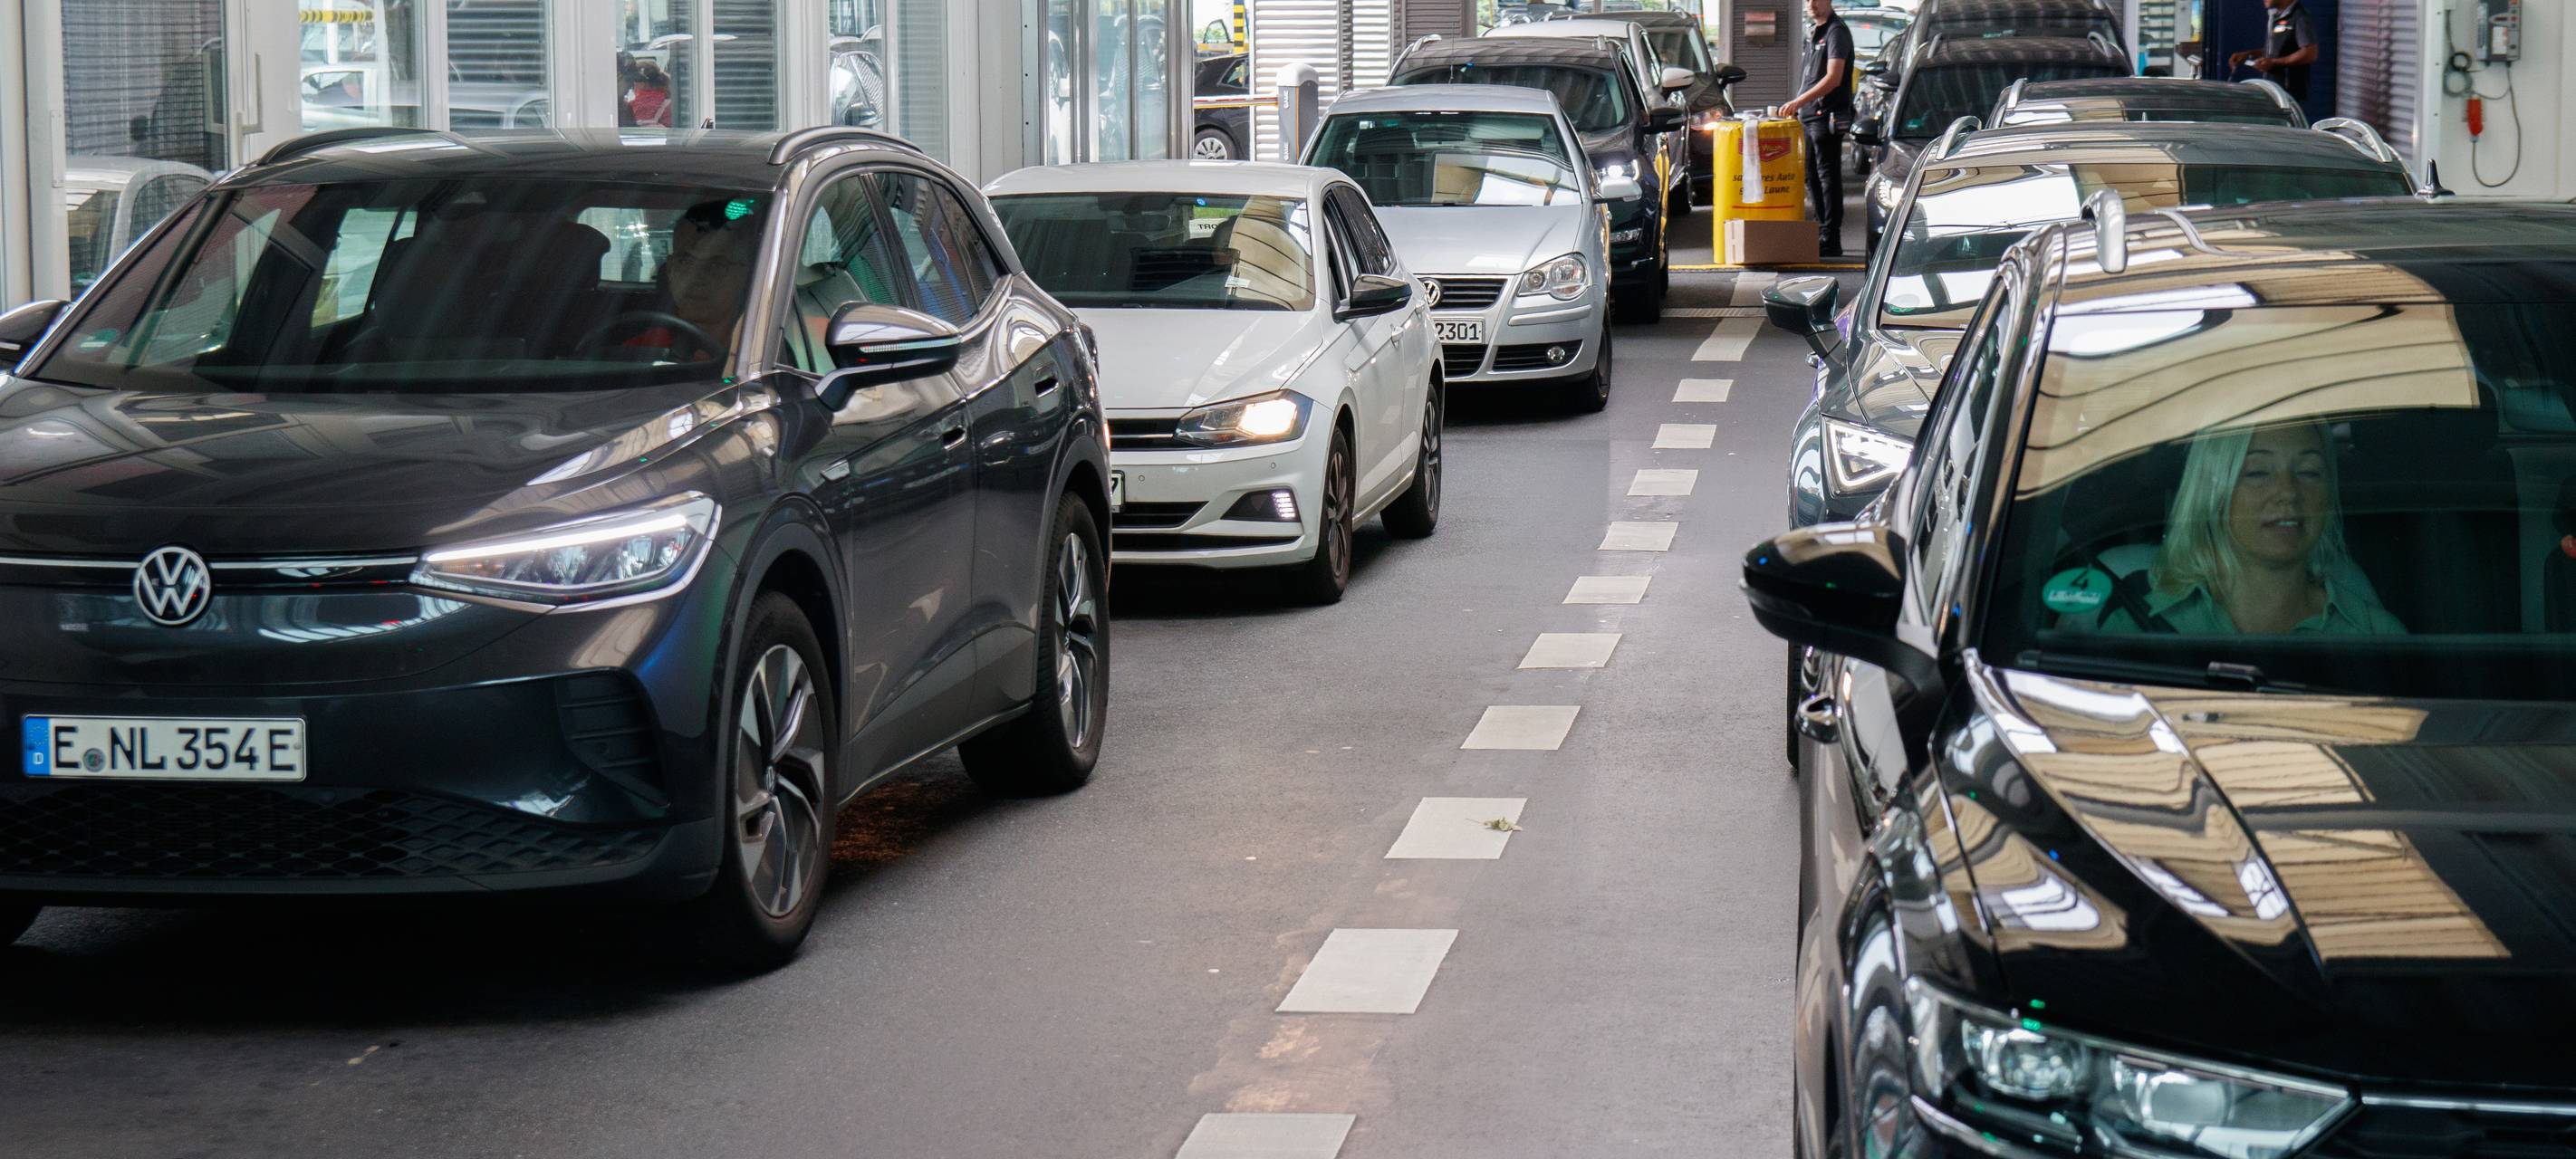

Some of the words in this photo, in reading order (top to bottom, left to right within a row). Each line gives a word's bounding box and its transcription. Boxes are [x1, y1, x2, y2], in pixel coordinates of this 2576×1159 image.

[1733, 173, 1774, 182] sares
[1776, 172, 1795, 182] Auto
[1764, 185, 1791, 195] Laune
